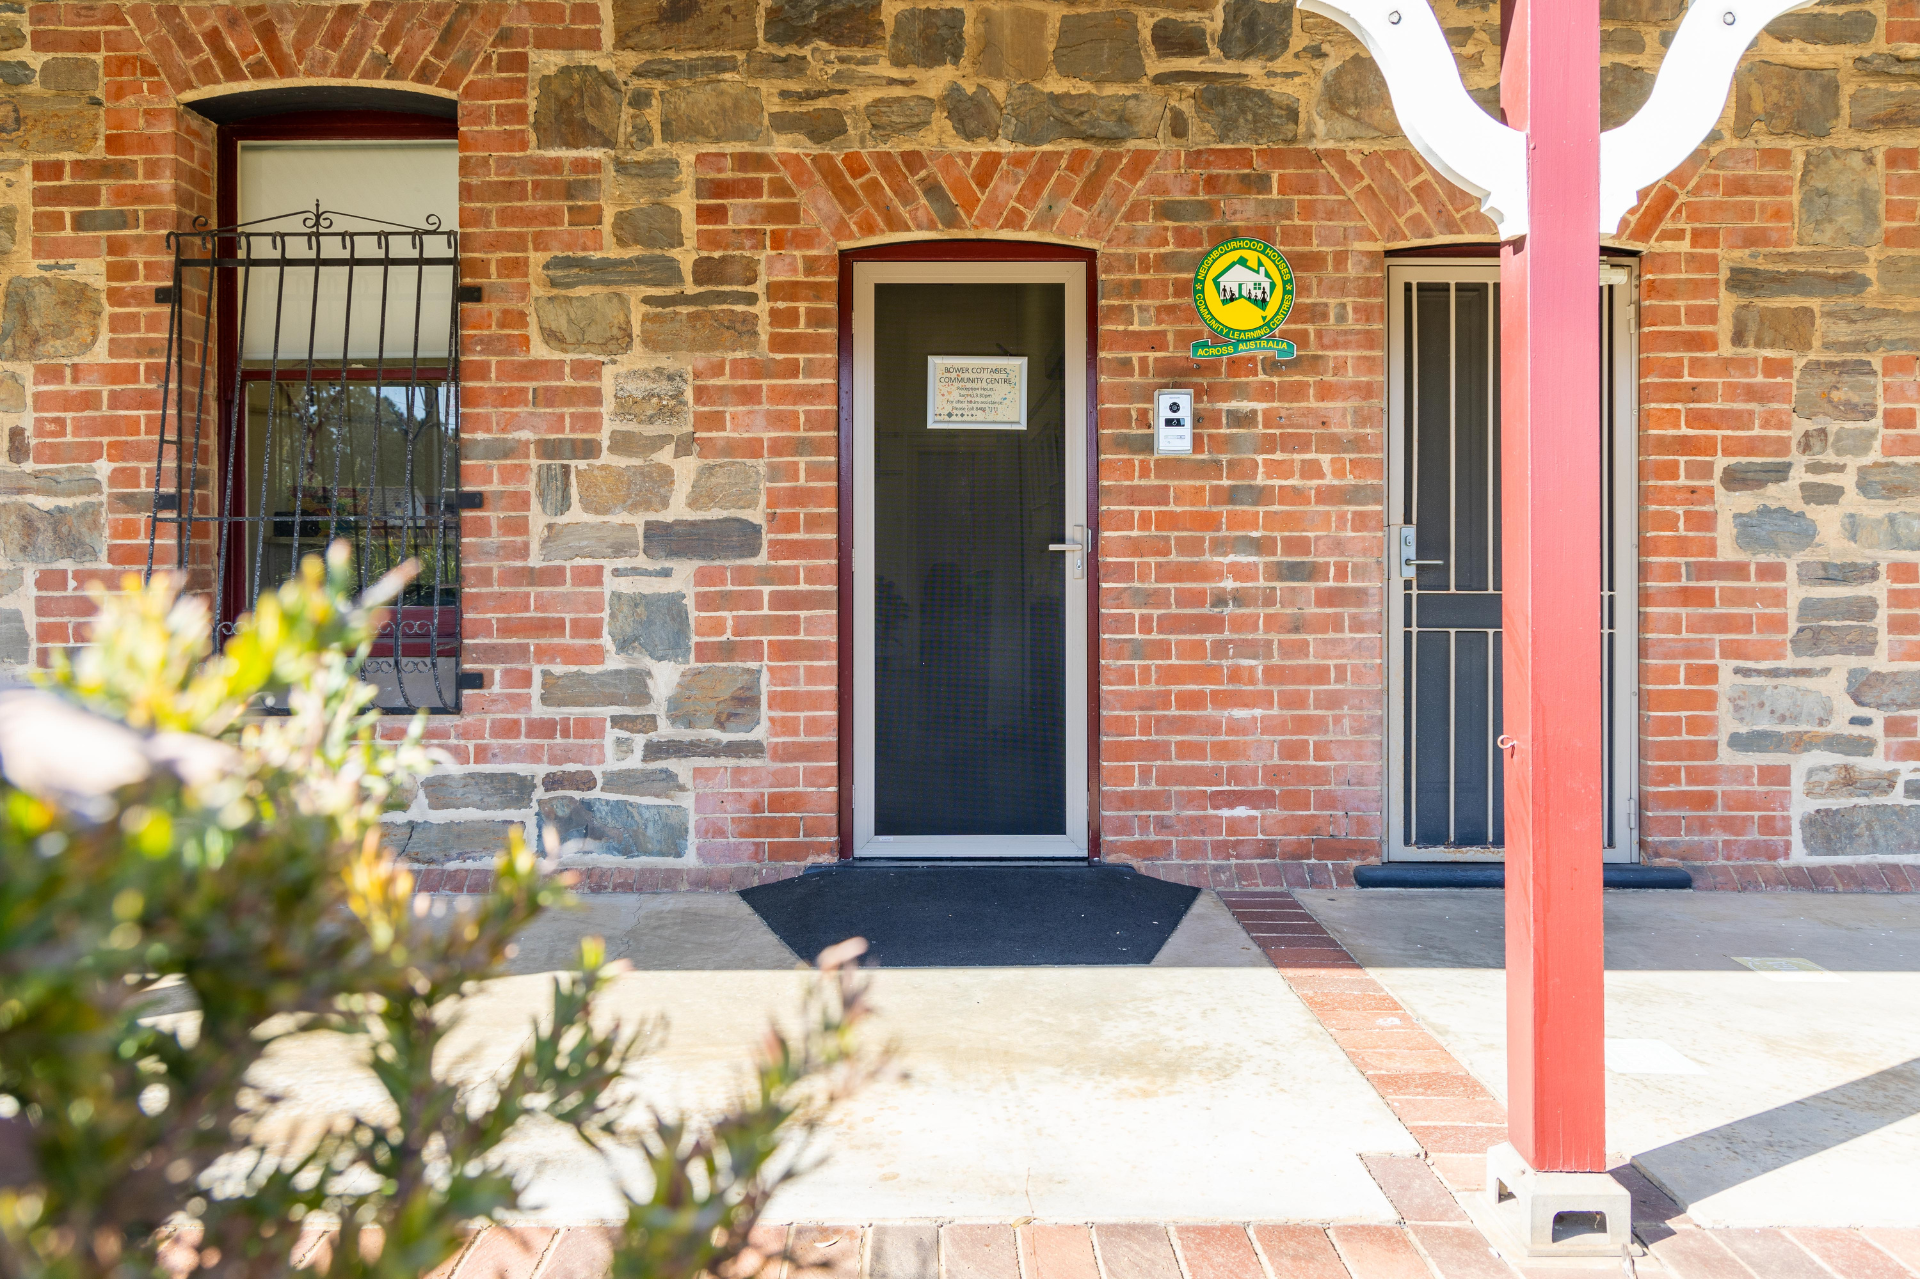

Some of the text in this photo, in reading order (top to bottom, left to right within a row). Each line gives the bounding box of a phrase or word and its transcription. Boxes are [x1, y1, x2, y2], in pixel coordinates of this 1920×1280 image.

[1197, 240, 1291, 281] NEIGHBOURHOOD HOUSES
[1195, 293, 1293, 340] COMMUNITY LEARNING CENTRES
[1197, 340, 1288, 356] ACROSS AUSTRALIA
[939, 376, 984, 384] COMMUNITY
